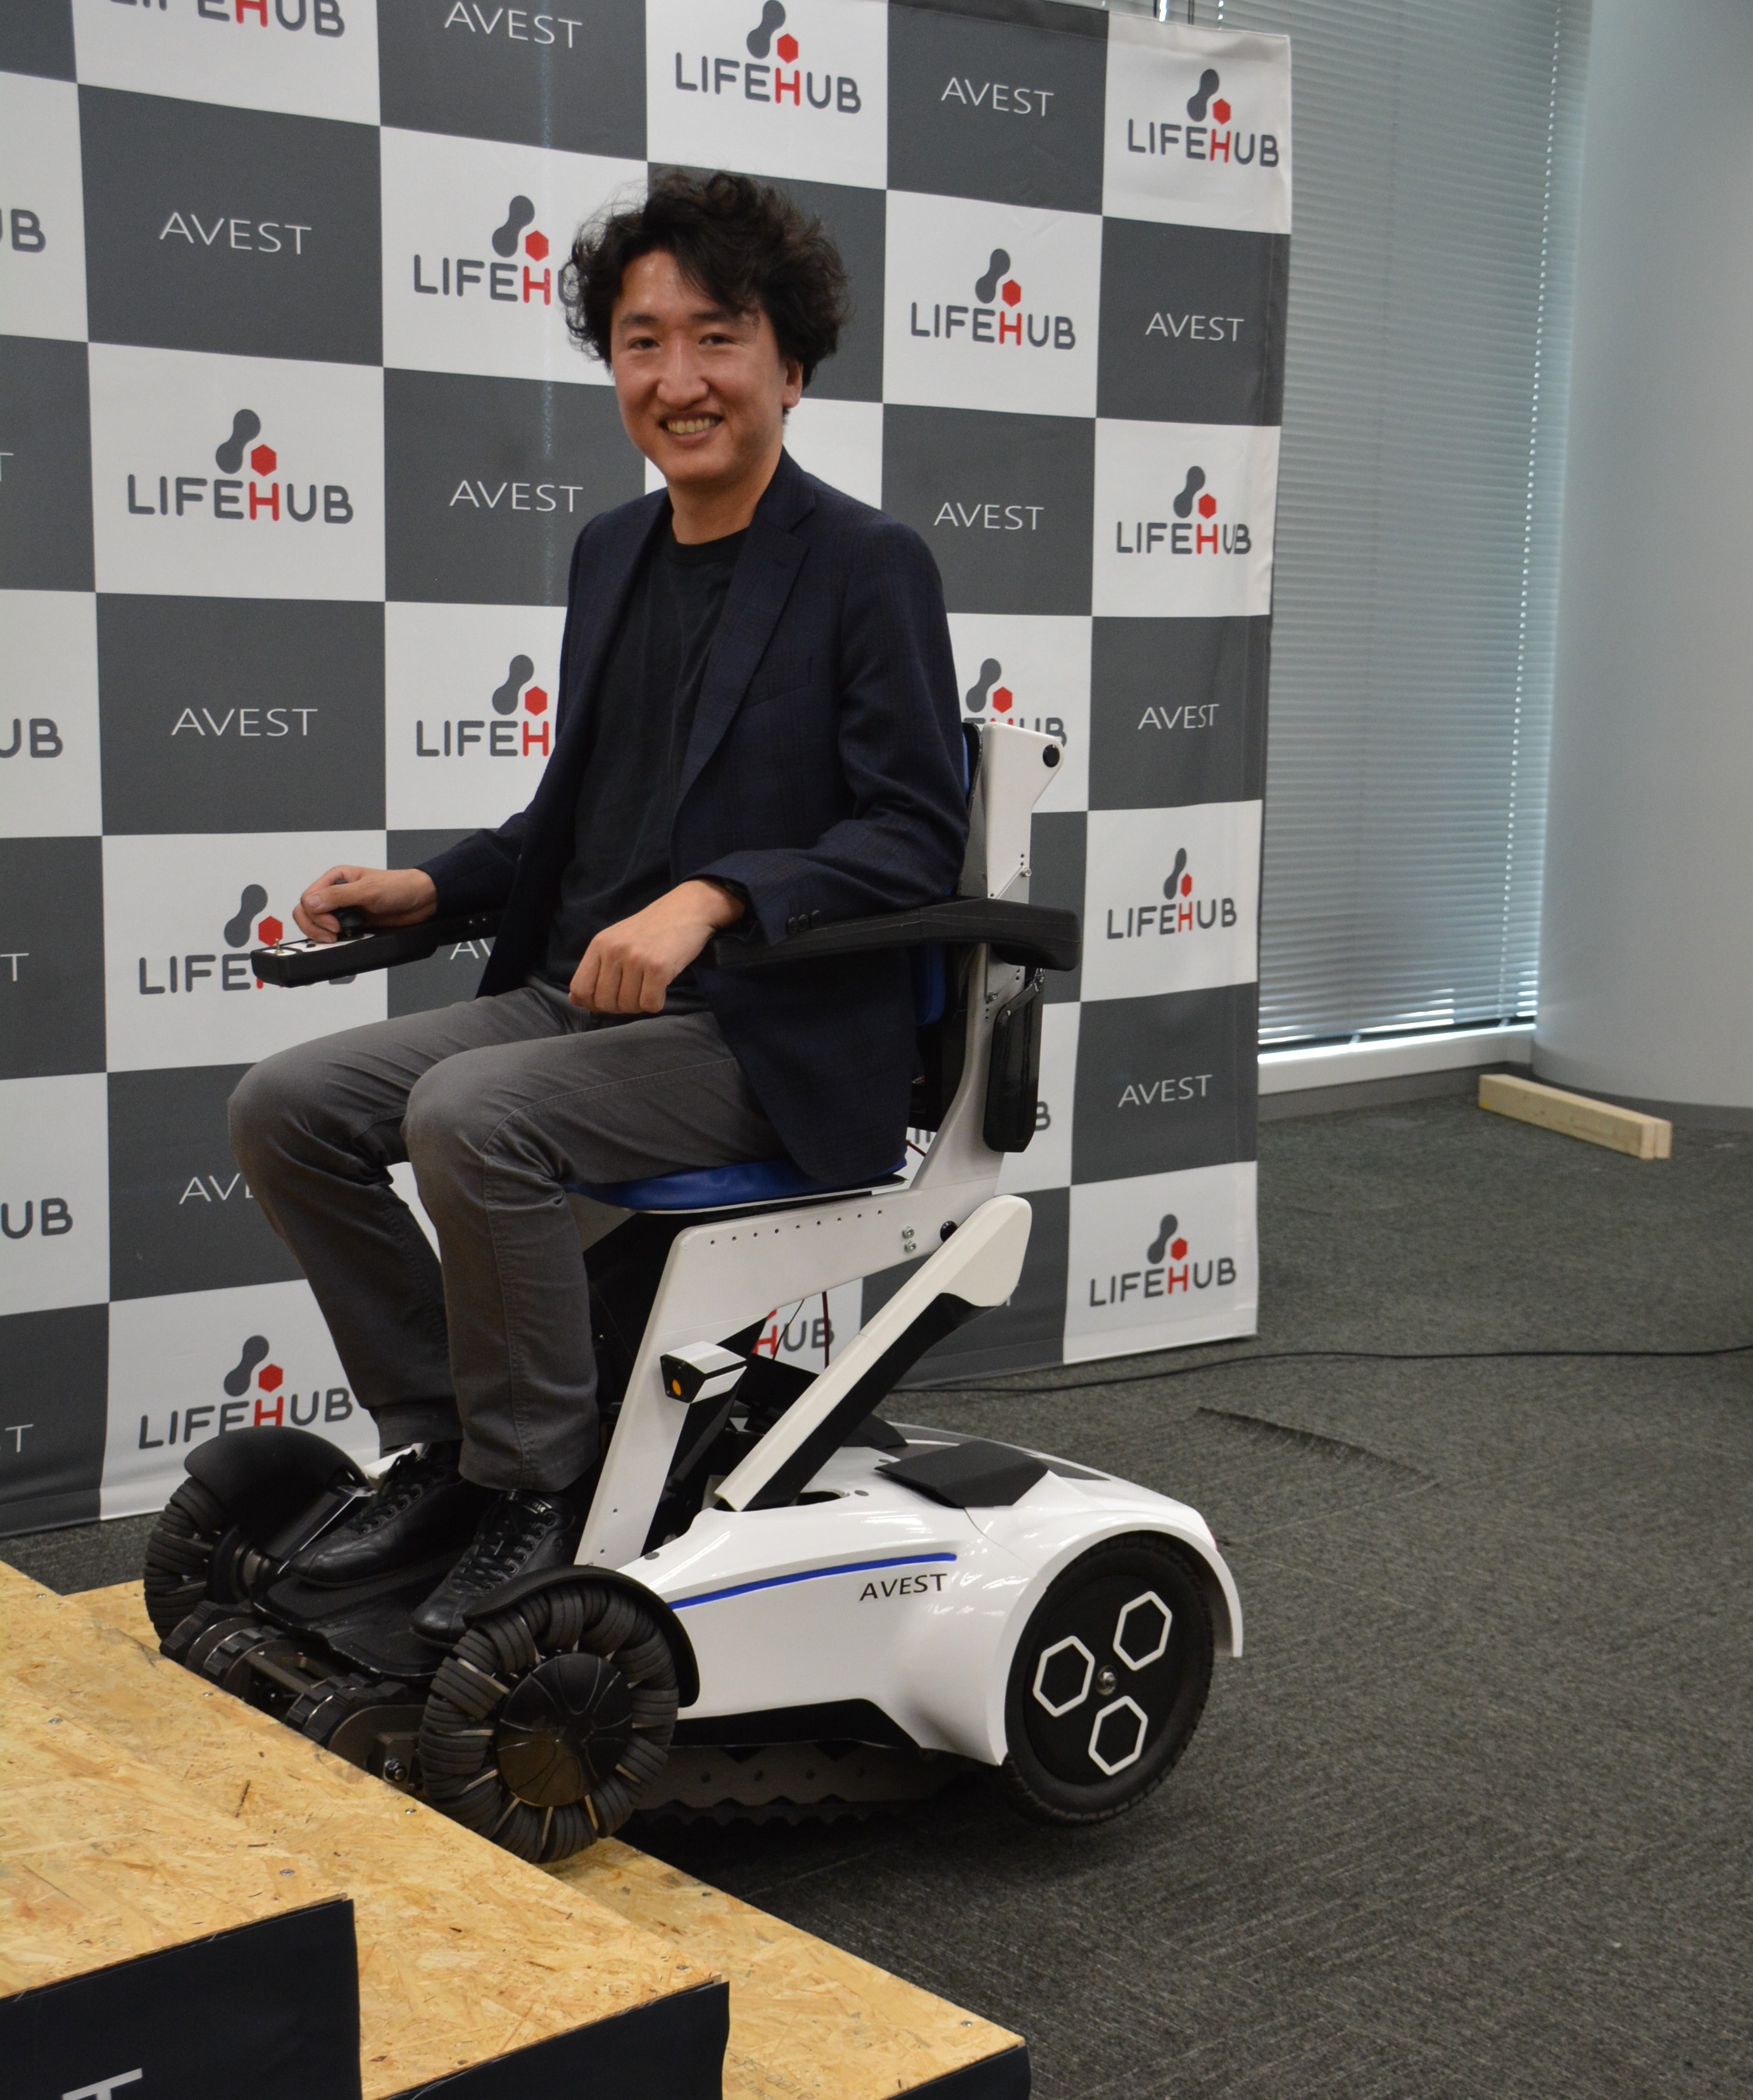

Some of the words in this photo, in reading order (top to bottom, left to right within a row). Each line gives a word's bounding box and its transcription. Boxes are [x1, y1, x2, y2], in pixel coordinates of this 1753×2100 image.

[444, 1, 582, 48] AVEST
[675, 52, 862, 114] LIFEHUB
[941, 77, 1054, 116] AVEST
[1128, 118, 1279, 168] LIFEHUB
[160, 212, 312, 254] AVEST
[911, 302, 1076, 350] LIFEHUB
[1145, 312, 1245, 342] AVEST
[128, 474, 353, 524] LIFEHUB
[449, 480, 584, 513] AVEST
[934, 502, 1045, 530] AVEST
[1116, 521, 1252, 554] LIFEHUB
[171, 708, 318, 737] AVEST
[1138, 704, 1219, 730] AVEST
[416, 720, 550, 757] LIFEH
[1107, 897, 1237, 939] LIFEHUB
[1117, 1075, 1212, 1108] AVEST
[1090, 1257, 1237, 1307] LIFEHUB
[858, 1573, 947, 1601] AVEST
